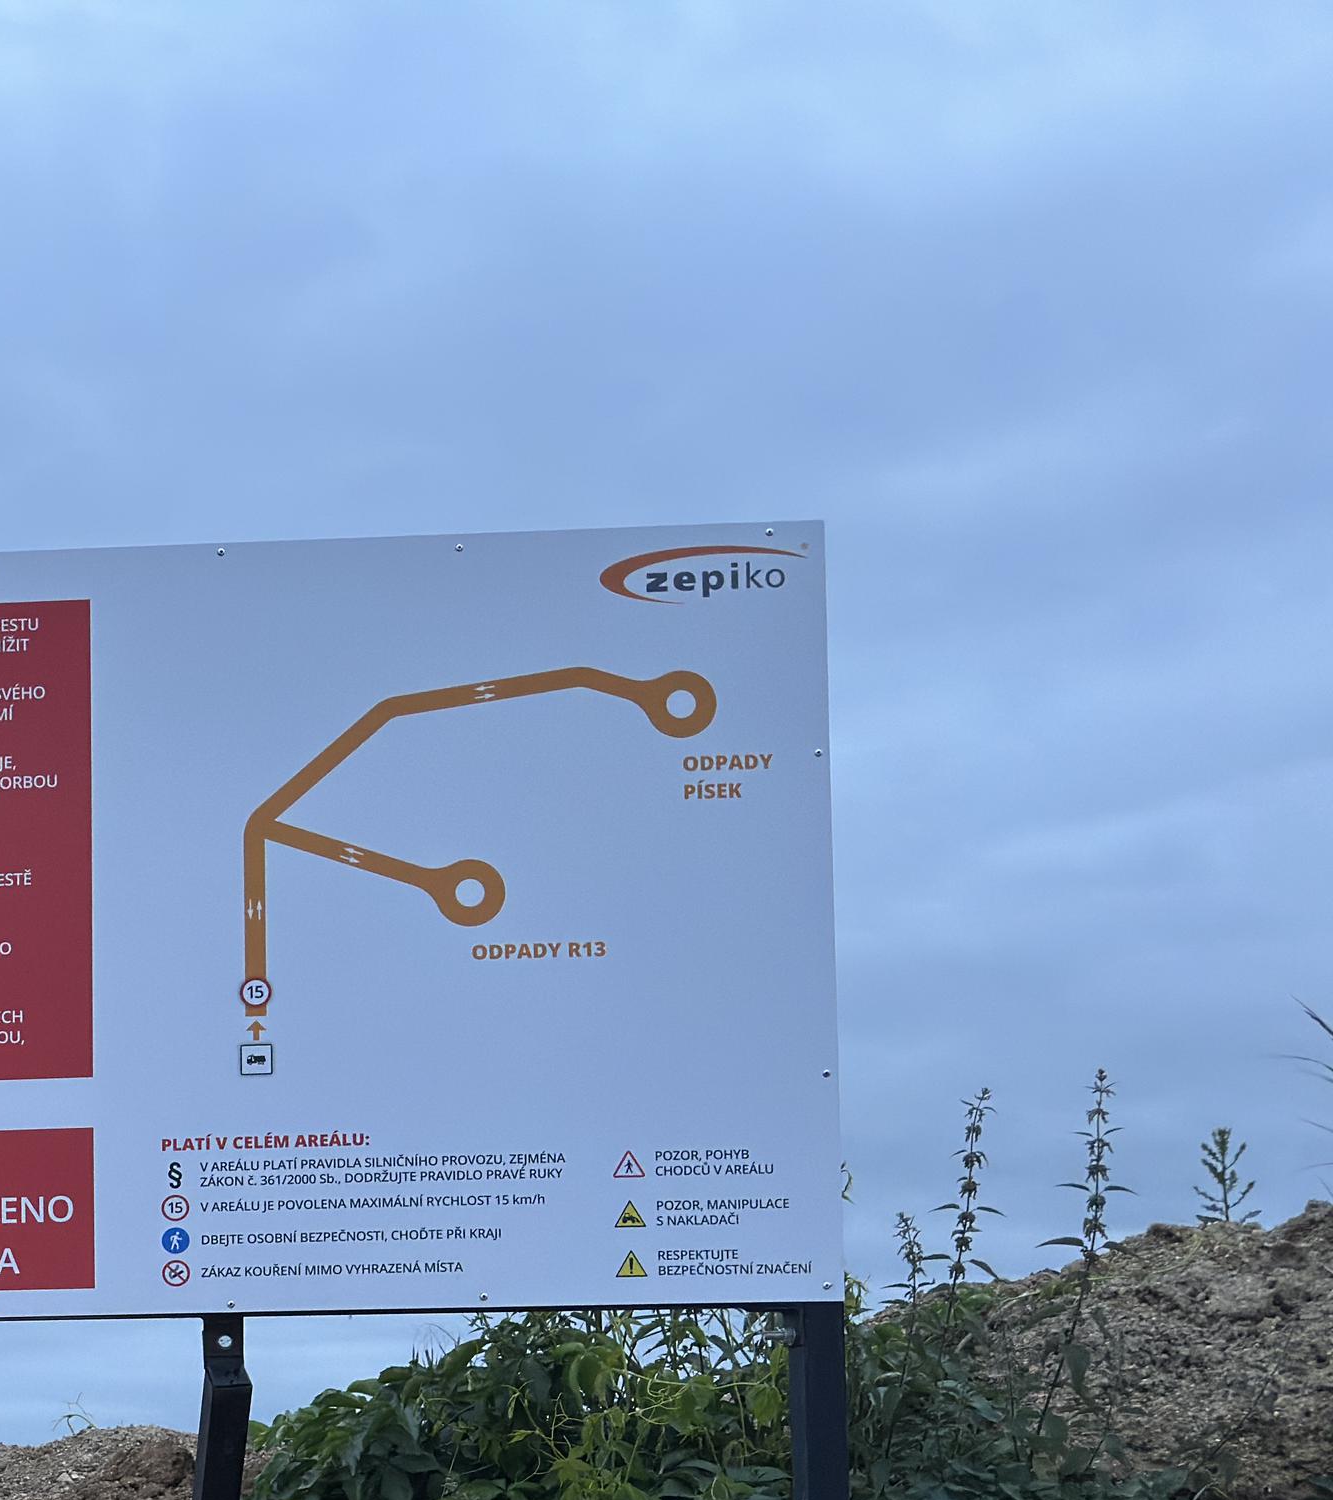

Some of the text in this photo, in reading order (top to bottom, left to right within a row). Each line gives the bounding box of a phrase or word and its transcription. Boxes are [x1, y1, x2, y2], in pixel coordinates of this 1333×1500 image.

[646, 561, 785, 597] zepiko
[683, 753, 773, 772] ODPADY
[684, 779, 742, 800] PÍSEK
[472, 941, 606, 961] ODPADY R13
[247, 985, 264, 999] 15
[161, 1129, 370, 1152] PLATÍ V CELÉM AREÁLU:
[199, 1150, 566, 1173] V AREÁLU PLATÍ PRAVIDLA SILNIČNÍHO PROVOZU, ZEJMÉNA
[655, 1149, 750, 1162] POZOR, POHYB
[200, 1174, 244, 1188] ZÁKON
[260, 1173, 317, 1186] 361/2000
[344, 1169, 417, 1185] DODRŽUJTE
[420, 1169, 483, 1182] PRAVIDLO
[486, 1166, 527, 1180] PRAVÉ
[529, 1168, 563, 1179] RUKY
[655, 1161, 774, 1177] CHODCŮ V AREÁLU
[168, 1201, 183, 1214] 15
[200, 1193, 545, 1214] V AREÁLU JE POVOLENA MAXIMÁLNÍ RYCHLOST 15 km/h
[656, 1198, 790, 1212] POZOR, MANIPULACE
[656, 1211, 739, 1227] S NAKLADAČI
[201, 1226, 502, 1247] DBEJTE OSOBNÍ BEZPEČNOSTI, CHOĎTE PŘI KRAJI
[657, 1249, 739, 1263] RESPEKTUJTE
[201, 1259, 464, 1278] ZÁKAZ KOUŘENÍ MIMO VYHRAZENÁ MÍSTA
[658, 1260, 812, 1276] BEZPEČNOSTNÍ ZNAČENÍ
